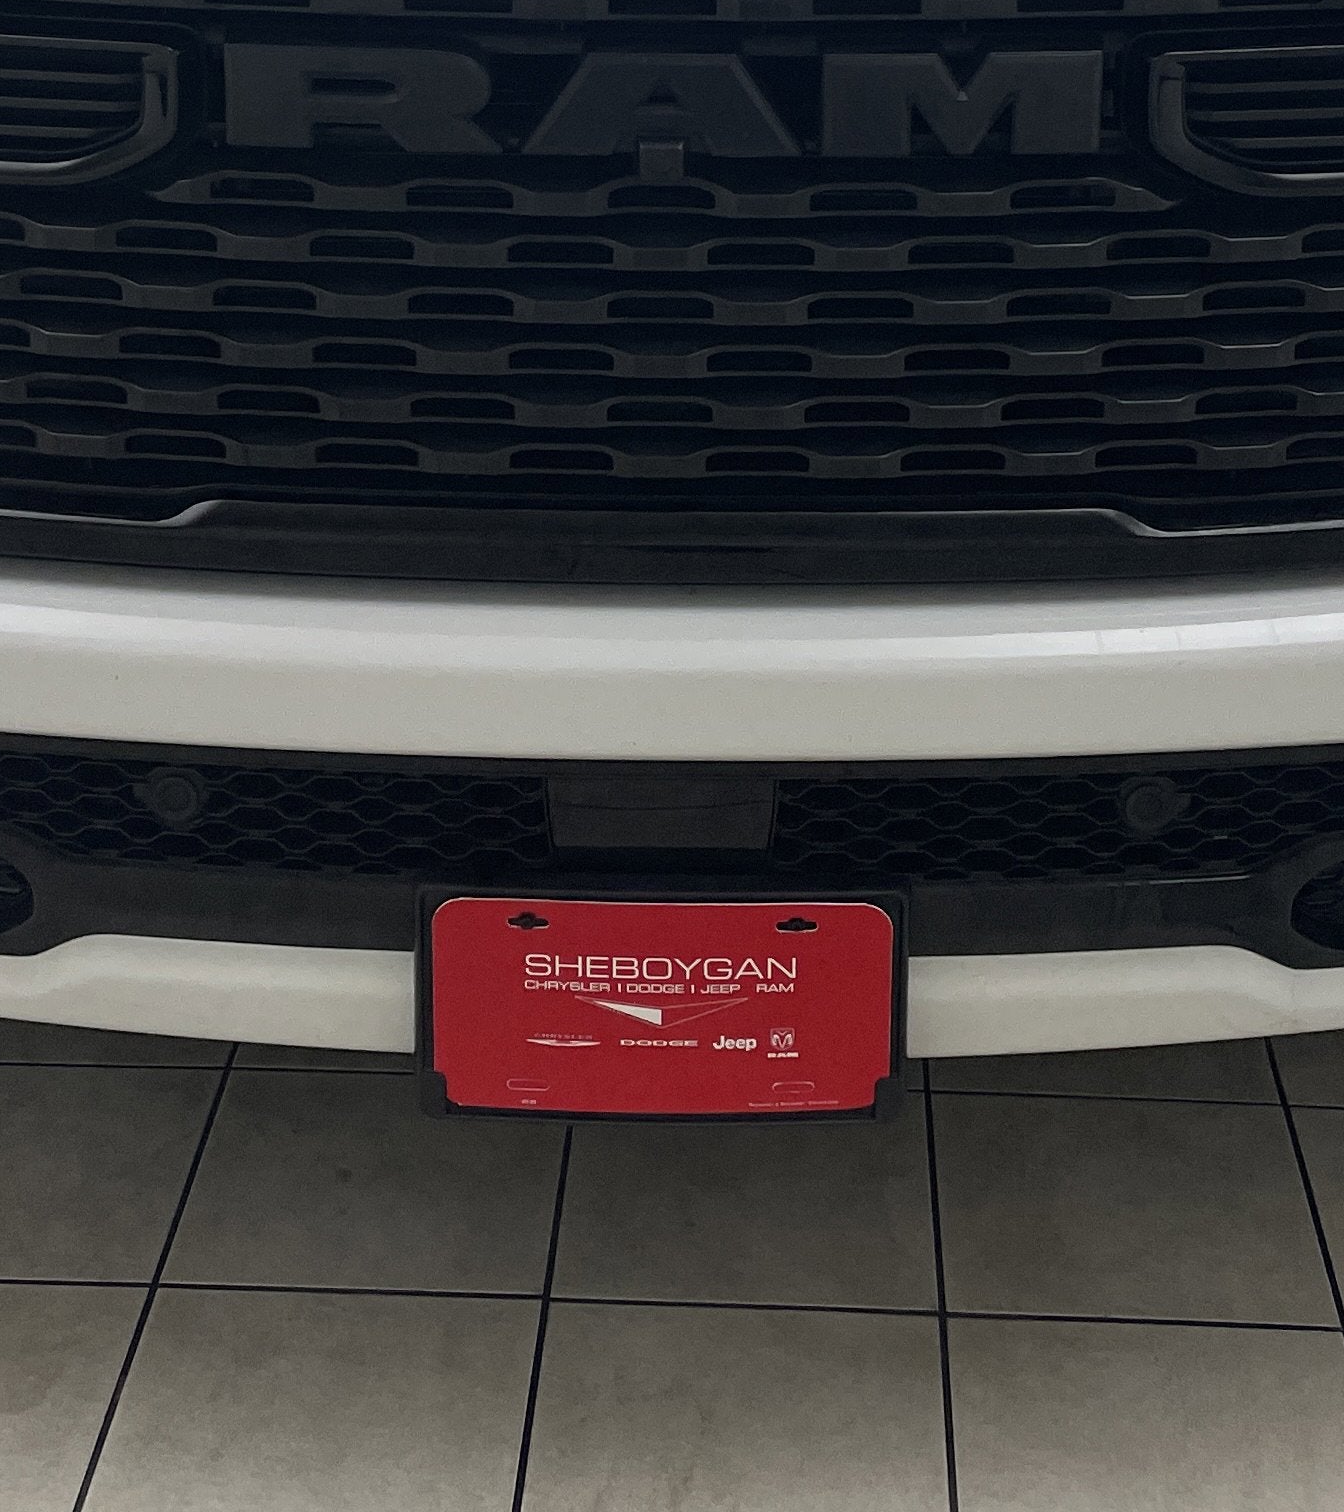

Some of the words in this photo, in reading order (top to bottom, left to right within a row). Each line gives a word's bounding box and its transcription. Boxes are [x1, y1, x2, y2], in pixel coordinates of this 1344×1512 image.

[222, 42, 1104, 156] RAM
[524, 953, 797, 980] SHEBOYGAN
[524, 978, 611, 993] CHRYSLER
[626, 982, 685, 994] DODGE
[700, 983, 741, 994] JEEP
[756, 982, 794, 993] RAM
[620, 1038, 698, 1047] DODGE
[712, 1035, 757, 1052] Jeep
